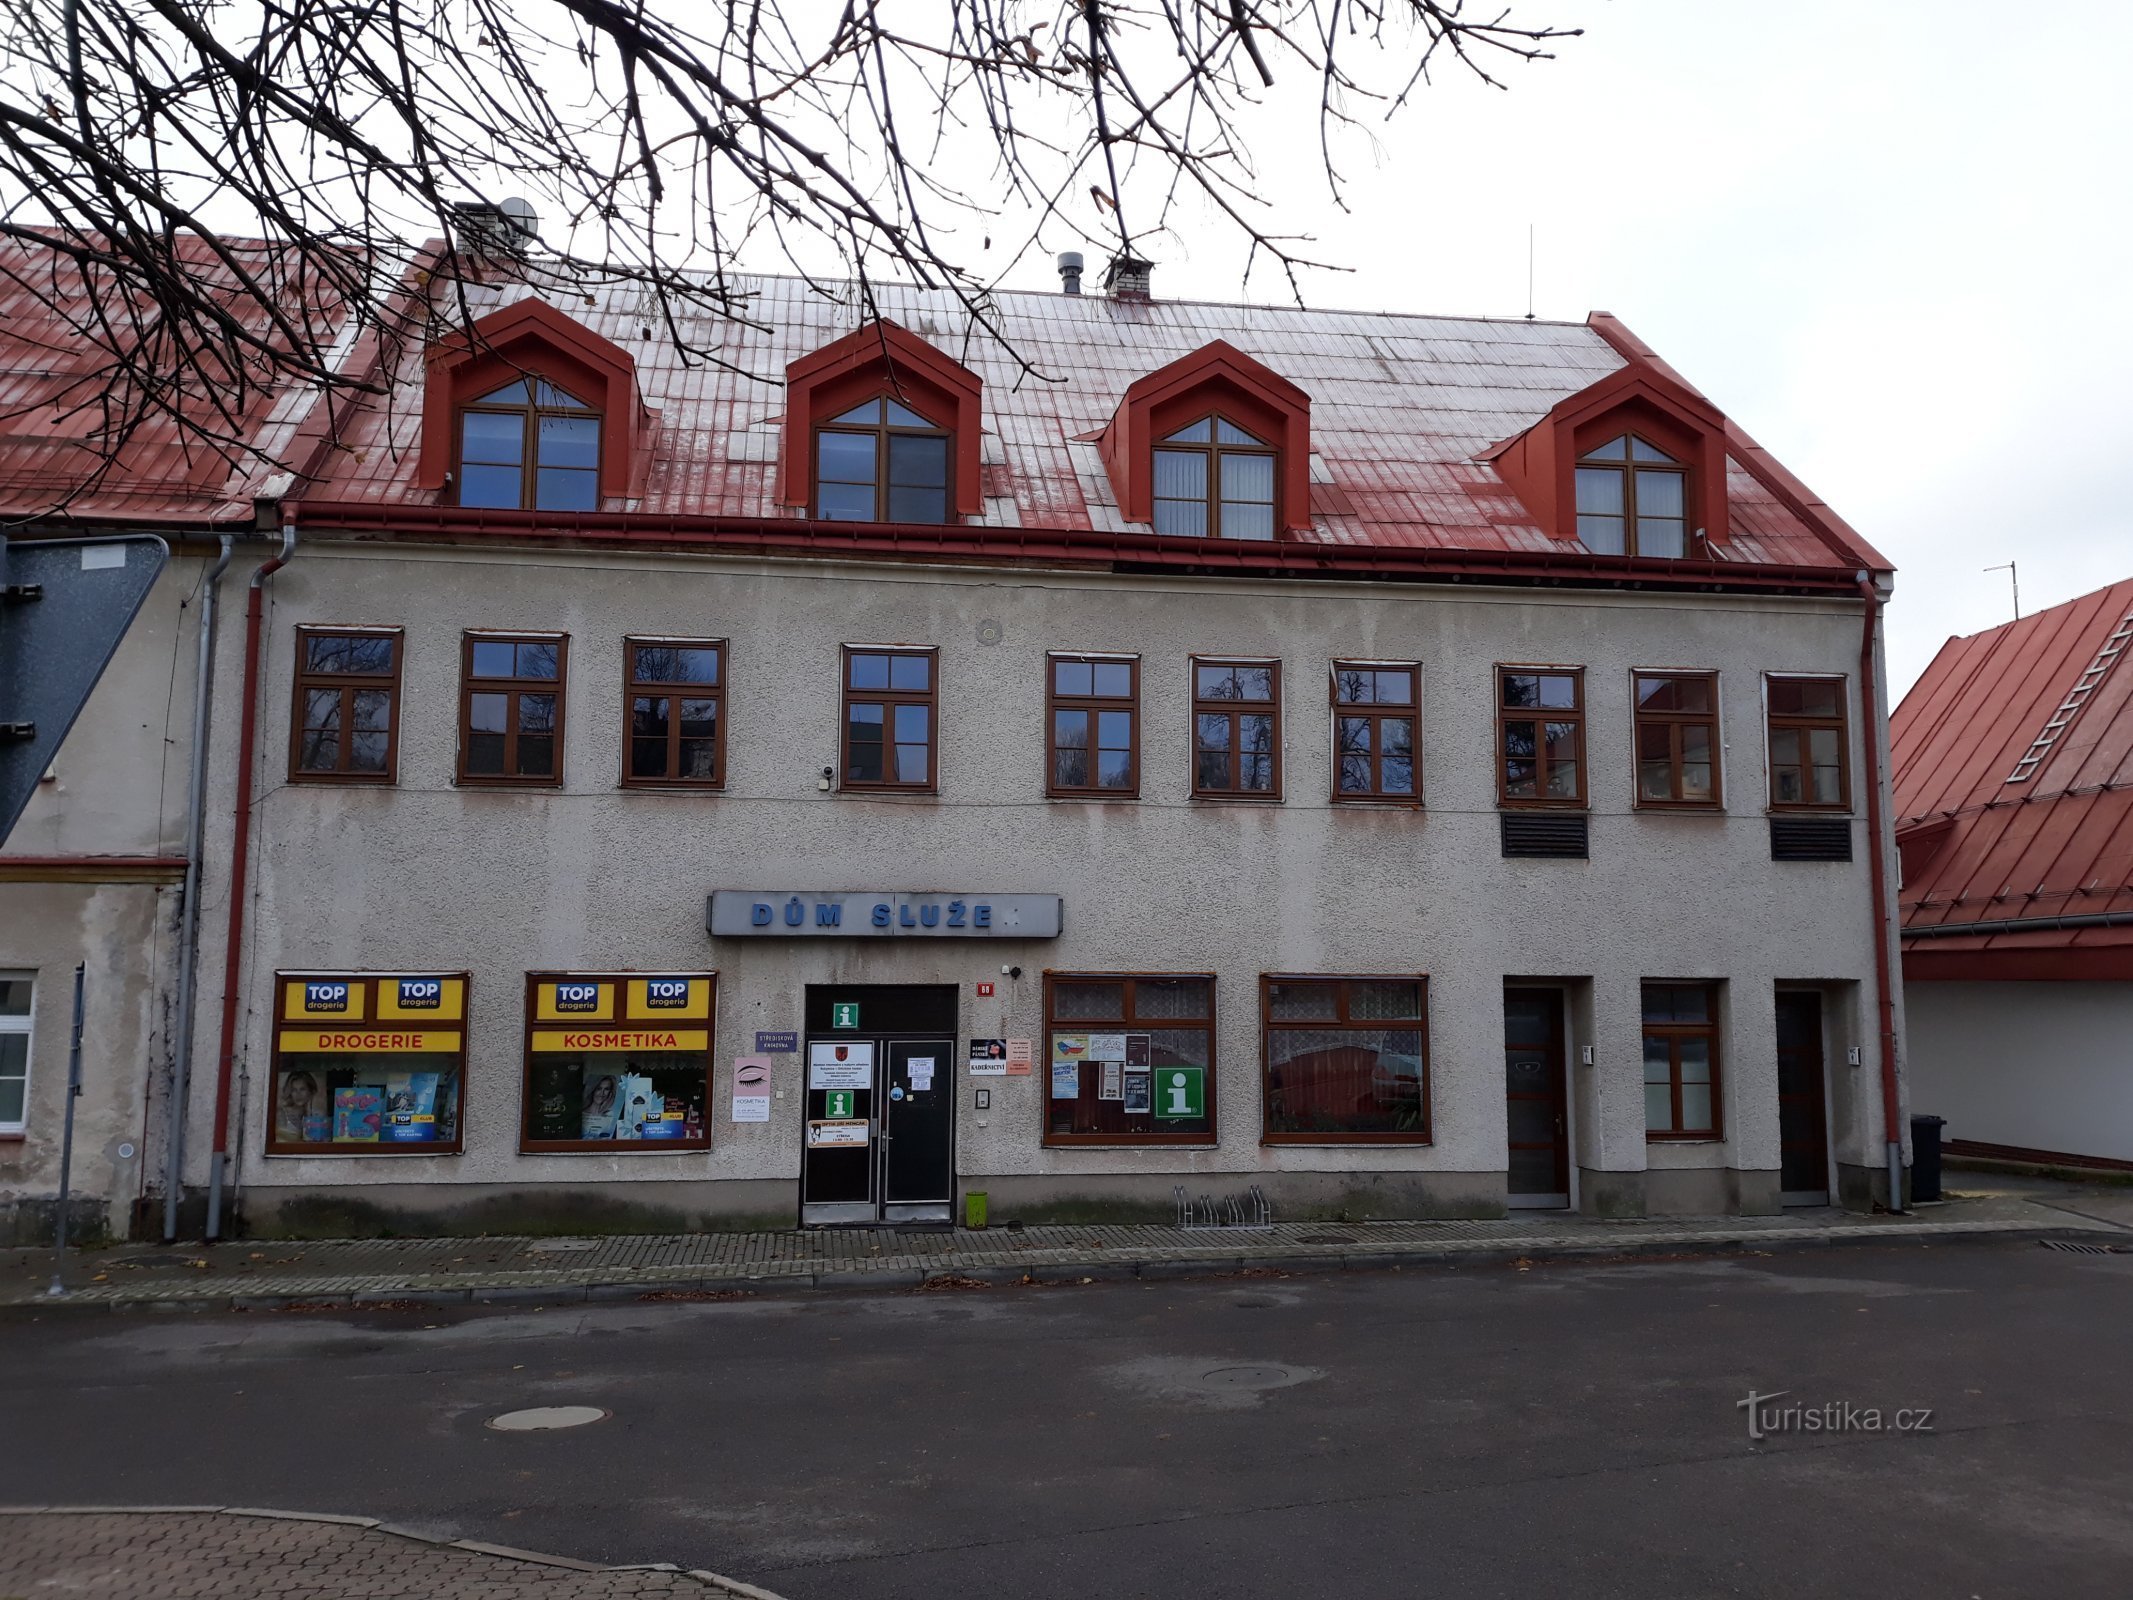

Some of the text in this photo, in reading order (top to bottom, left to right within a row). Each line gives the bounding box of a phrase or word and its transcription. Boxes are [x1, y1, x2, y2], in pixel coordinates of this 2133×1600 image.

[752, 896, 992, 928] DŮM SLUŽE
[308, 986, 346, 1000] TOP
[401, 983, 438, 997] TOP
[559, 986, 596, 1001] TOP
[650, 983, 686, 997] TOP
[308, 1001, 345, 1010] drogerie
[400, 998, 438, 1007] drogerie
[558, 1002, 595, 1010] drogerie
[650, 998, 685, 1006] drogerie
[318, 1034, 423, 1048] DROGERIE
[564, 1033, 677, 1048] KOSMETIKA
